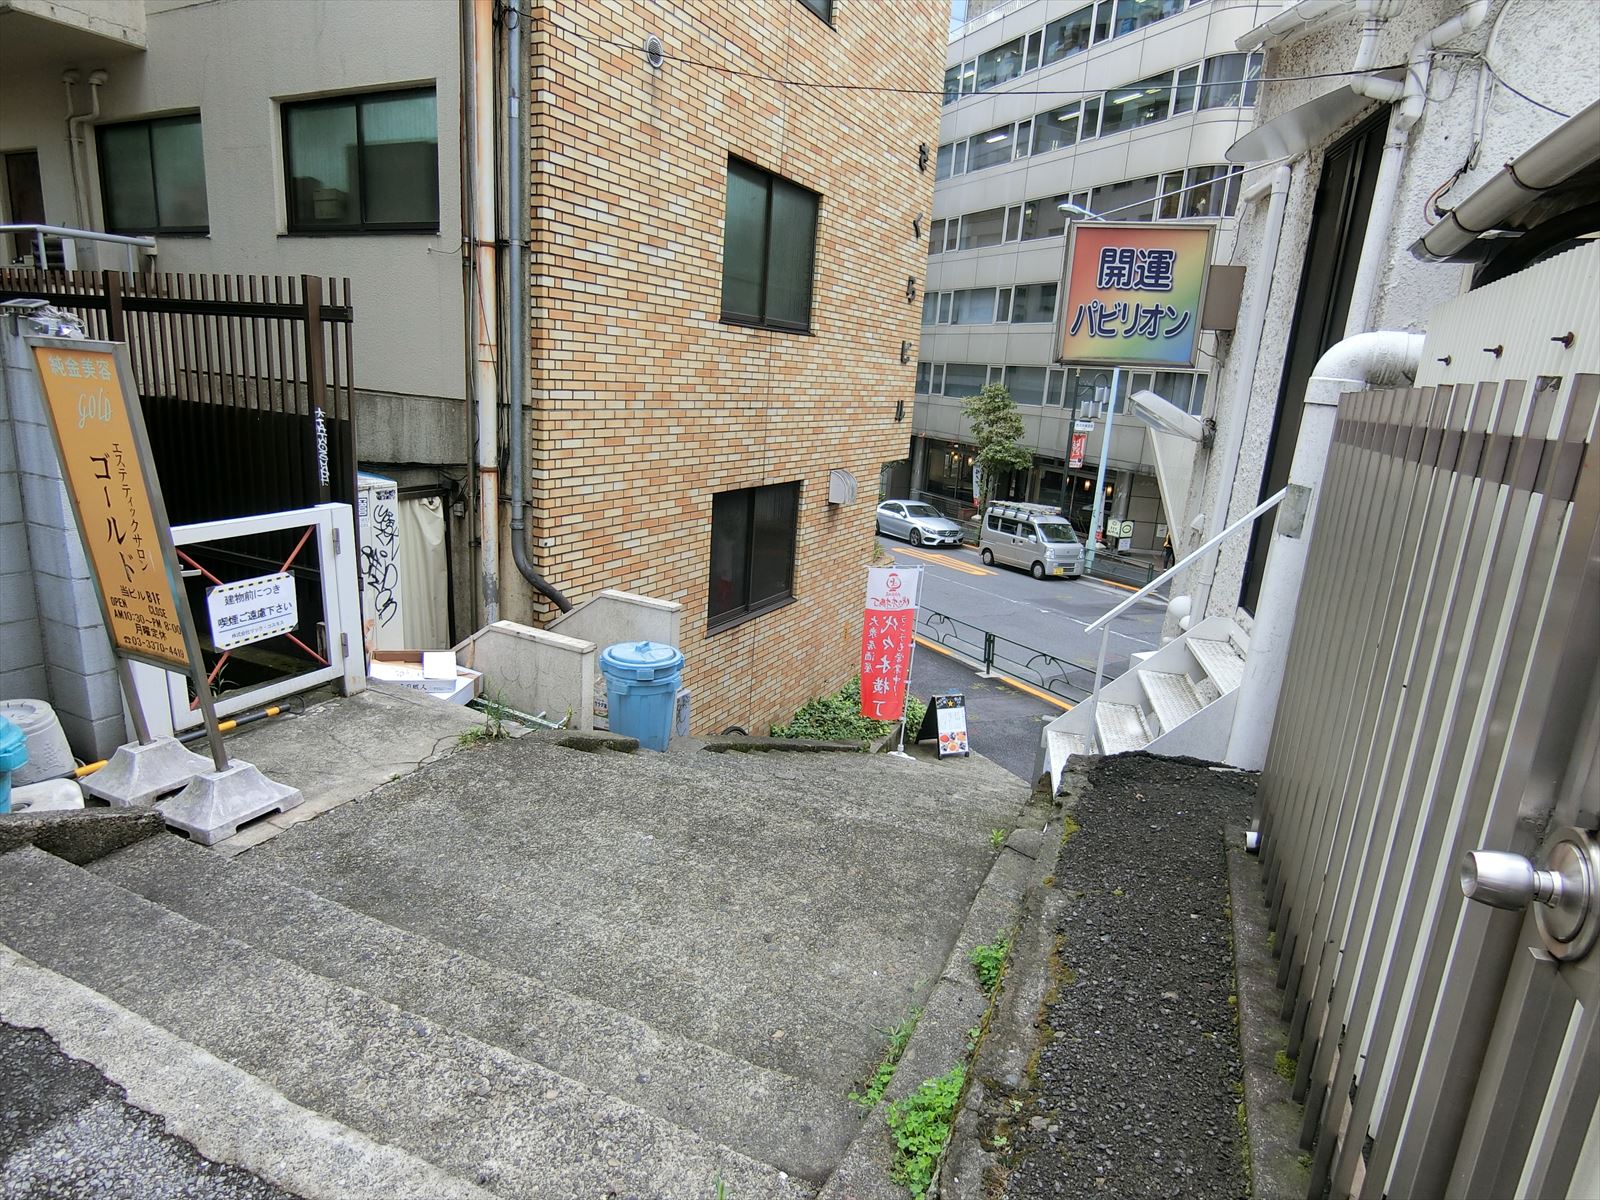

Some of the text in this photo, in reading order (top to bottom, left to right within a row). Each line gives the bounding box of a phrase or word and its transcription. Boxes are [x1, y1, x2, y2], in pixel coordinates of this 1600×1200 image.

[1097, 247, 1176, 290] 開運
[1070, 300, 1190, 338] パビリオン
[89, 453, 135, 583] ゴールド
[112, 443, 149, 572] エステティックサロン
[110, 596, 168, 619] OPEN CLOSE
[224, 584, 281, 606] 建物前につき
[135, 623, 167, 640] 月曜定休
[217, 602, 293, 629] 喫煙ご遠慮下さい
